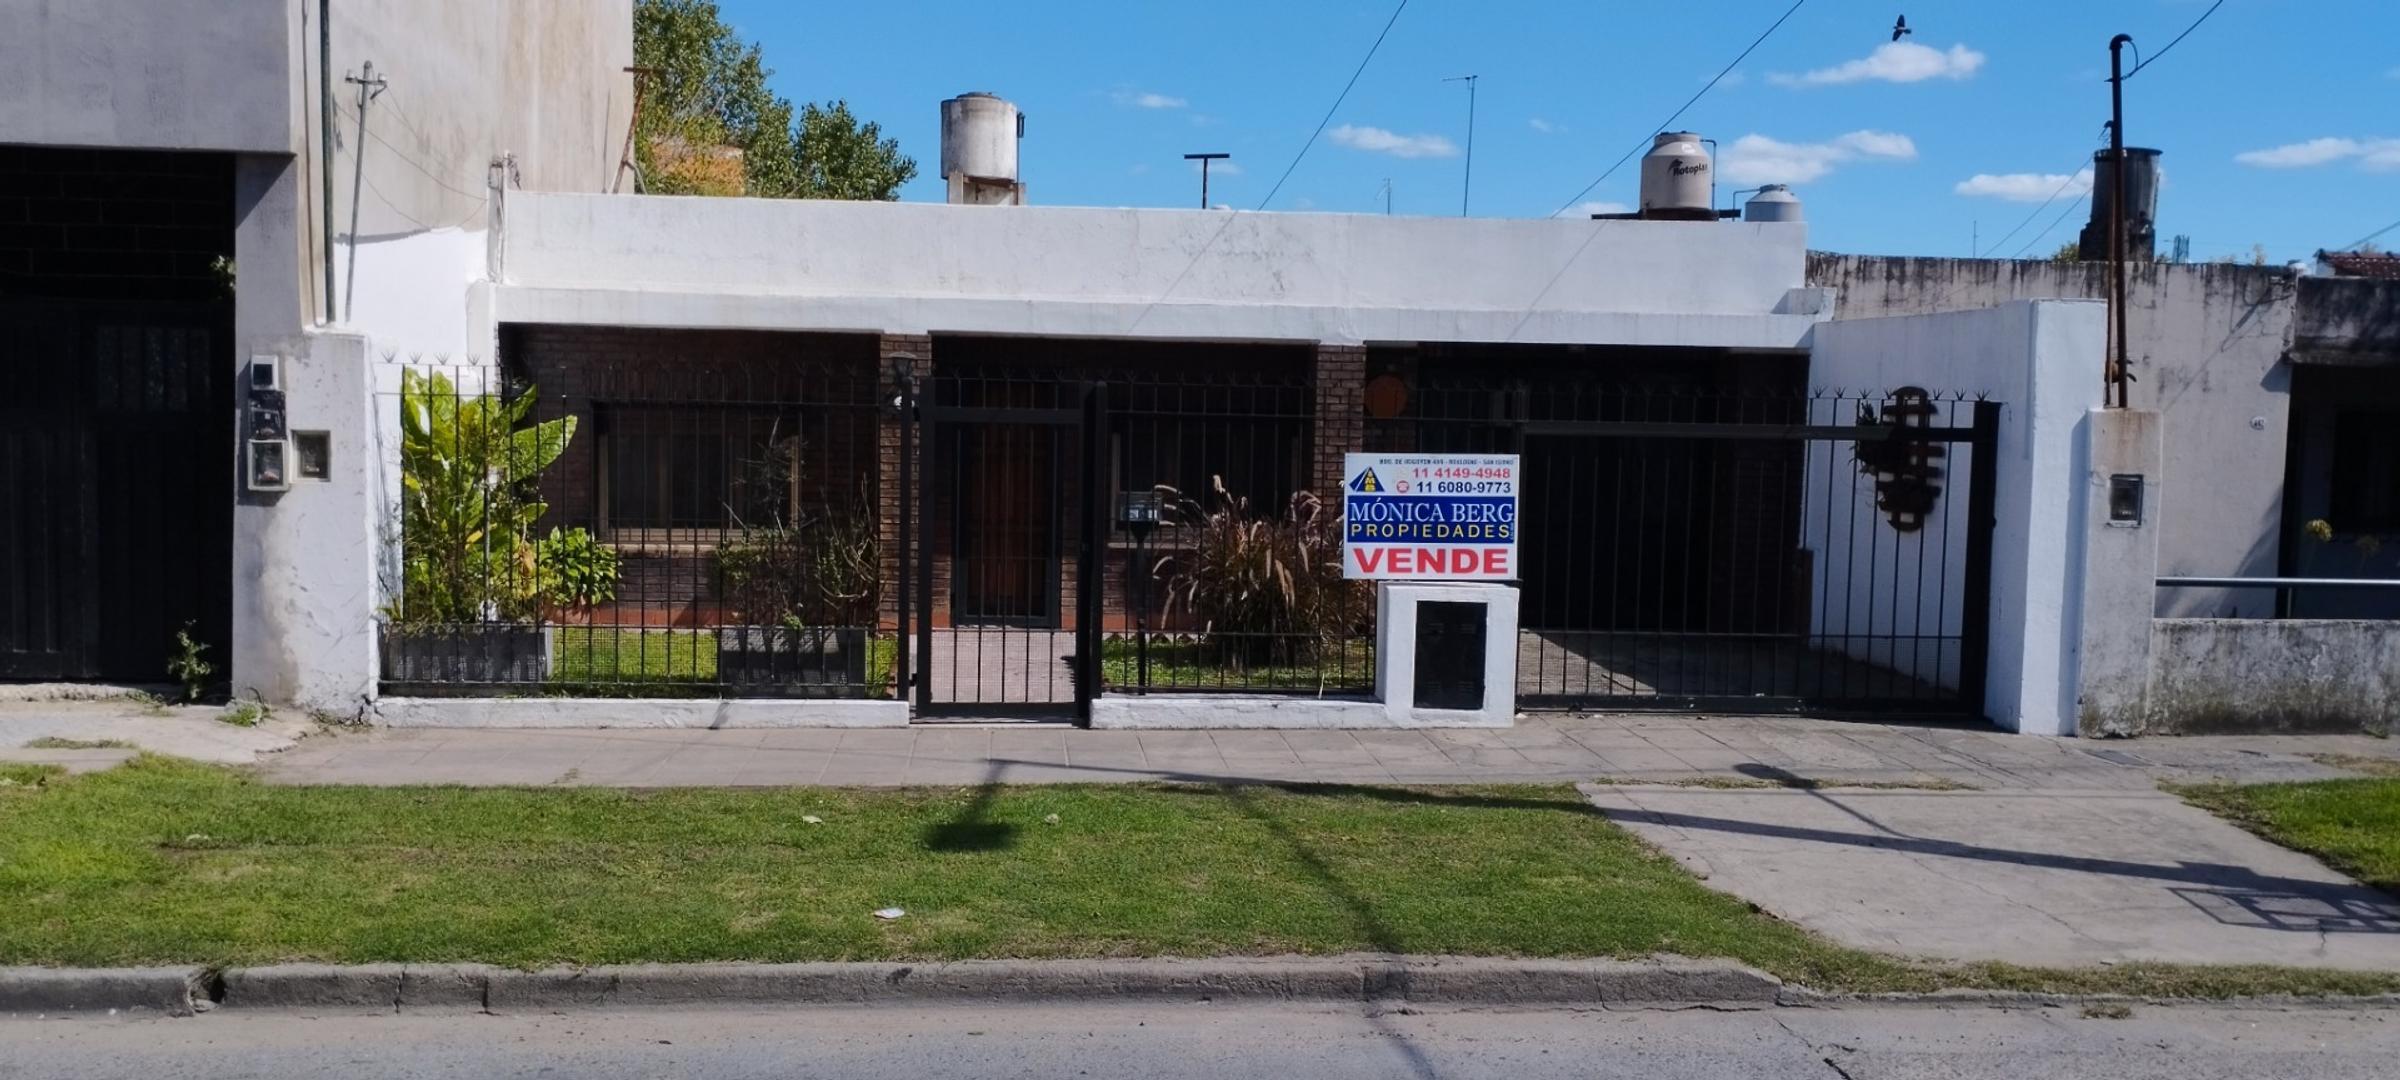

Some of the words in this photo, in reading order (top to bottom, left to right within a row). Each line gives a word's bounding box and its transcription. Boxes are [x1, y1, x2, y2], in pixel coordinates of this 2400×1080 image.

[1413, 468, 1429, 478] 11
[1434, 468, 1511, 478] 4149-4948
[1416, 482, 1433, 493] 11
[1438, 482, 1511, 493] 6080-9773
[1350, 497, 1444, 522] MÓNICA
[1451, 502, 1514, 523] BERG
[1351, 523, 1510, 538] PROPIEDADES
[1353, 548, 1509, 574] VENDE
